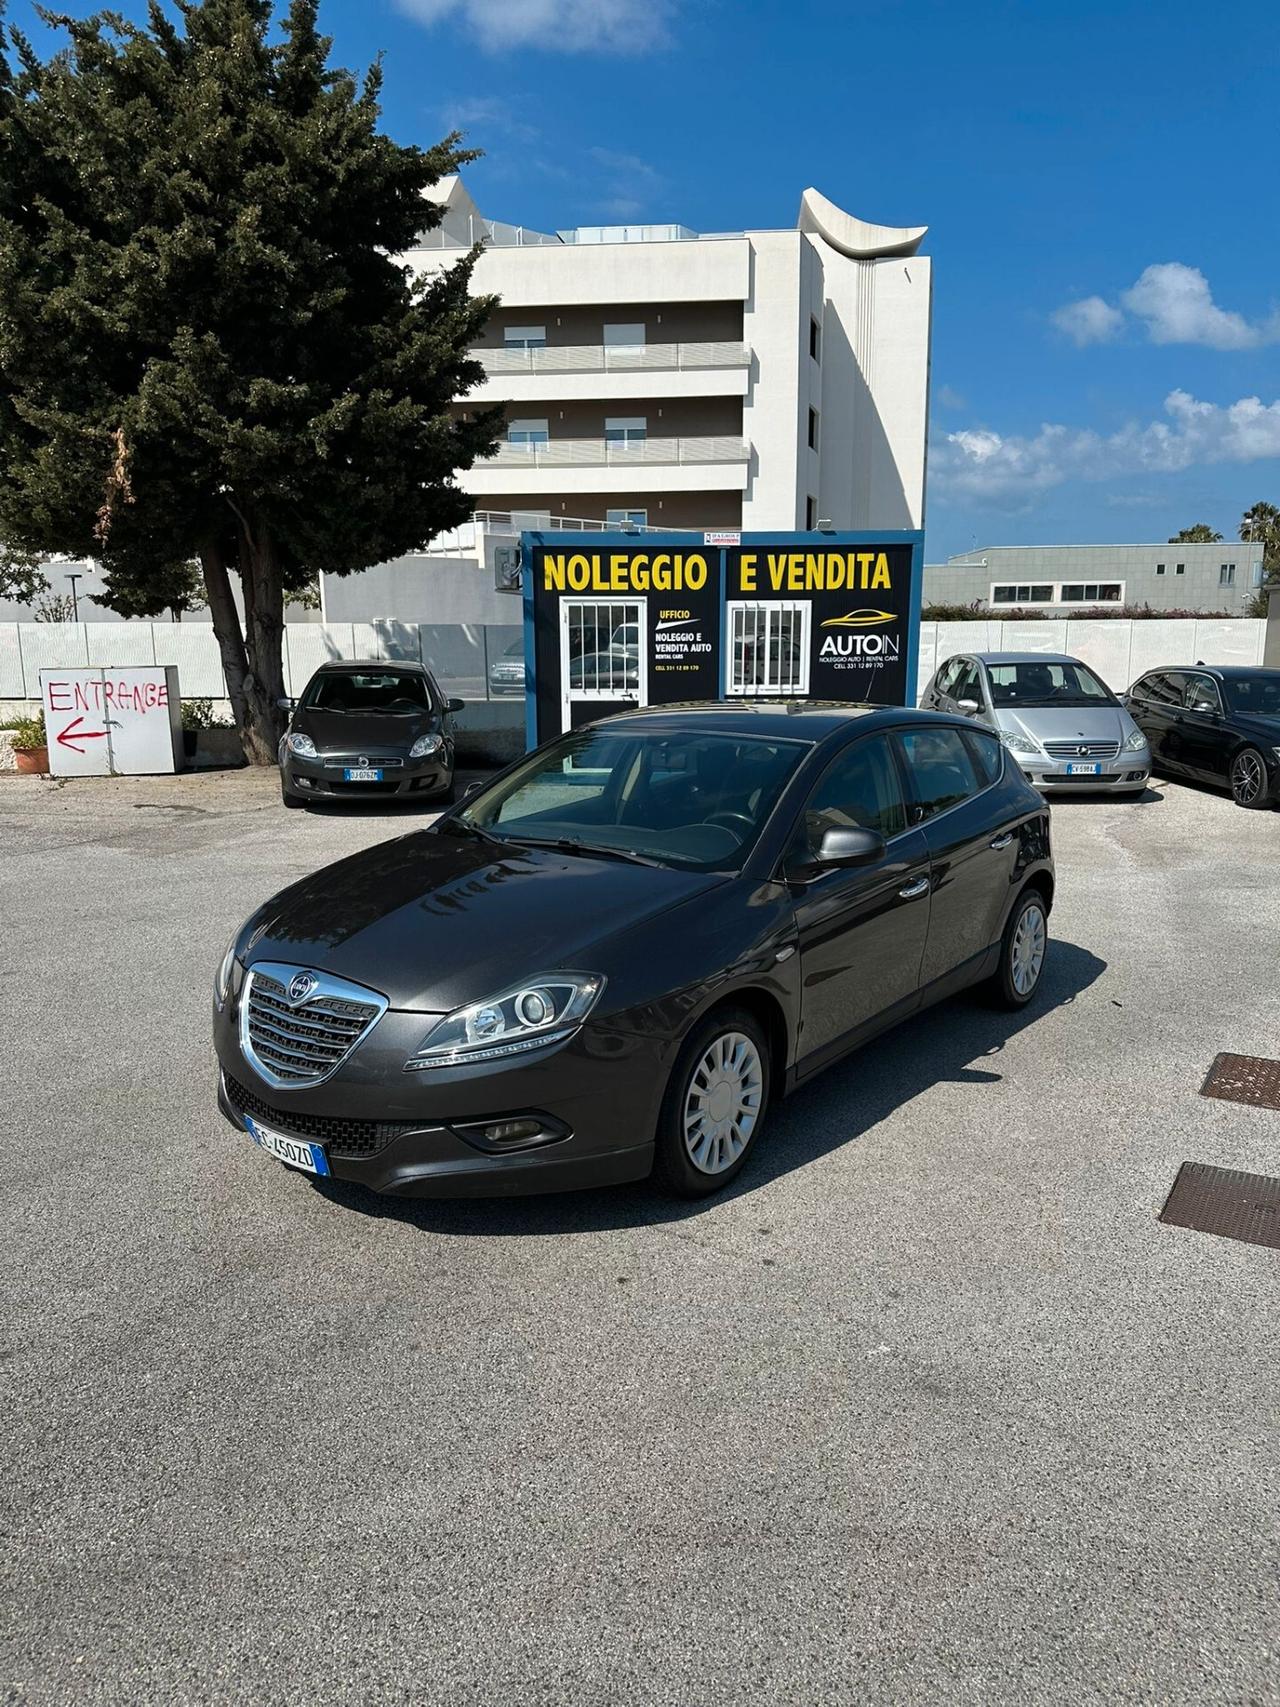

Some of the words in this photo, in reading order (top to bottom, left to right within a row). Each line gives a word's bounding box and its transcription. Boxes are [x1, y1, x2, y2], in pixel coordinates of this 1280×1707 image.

[544, 554, 708, 591] NOLEGGIO
[740, 555, 757, 591] E
[767, 553, 891, 591] VENDITA
[659, 610, 690, 619] UFFICIO
[655, 633, 694, 641] NOLEGGIO
[696, 633, 702, 641] E
[655, 643, 689, 652] VENDITA
[690, 643, 712, 652] AUTO
